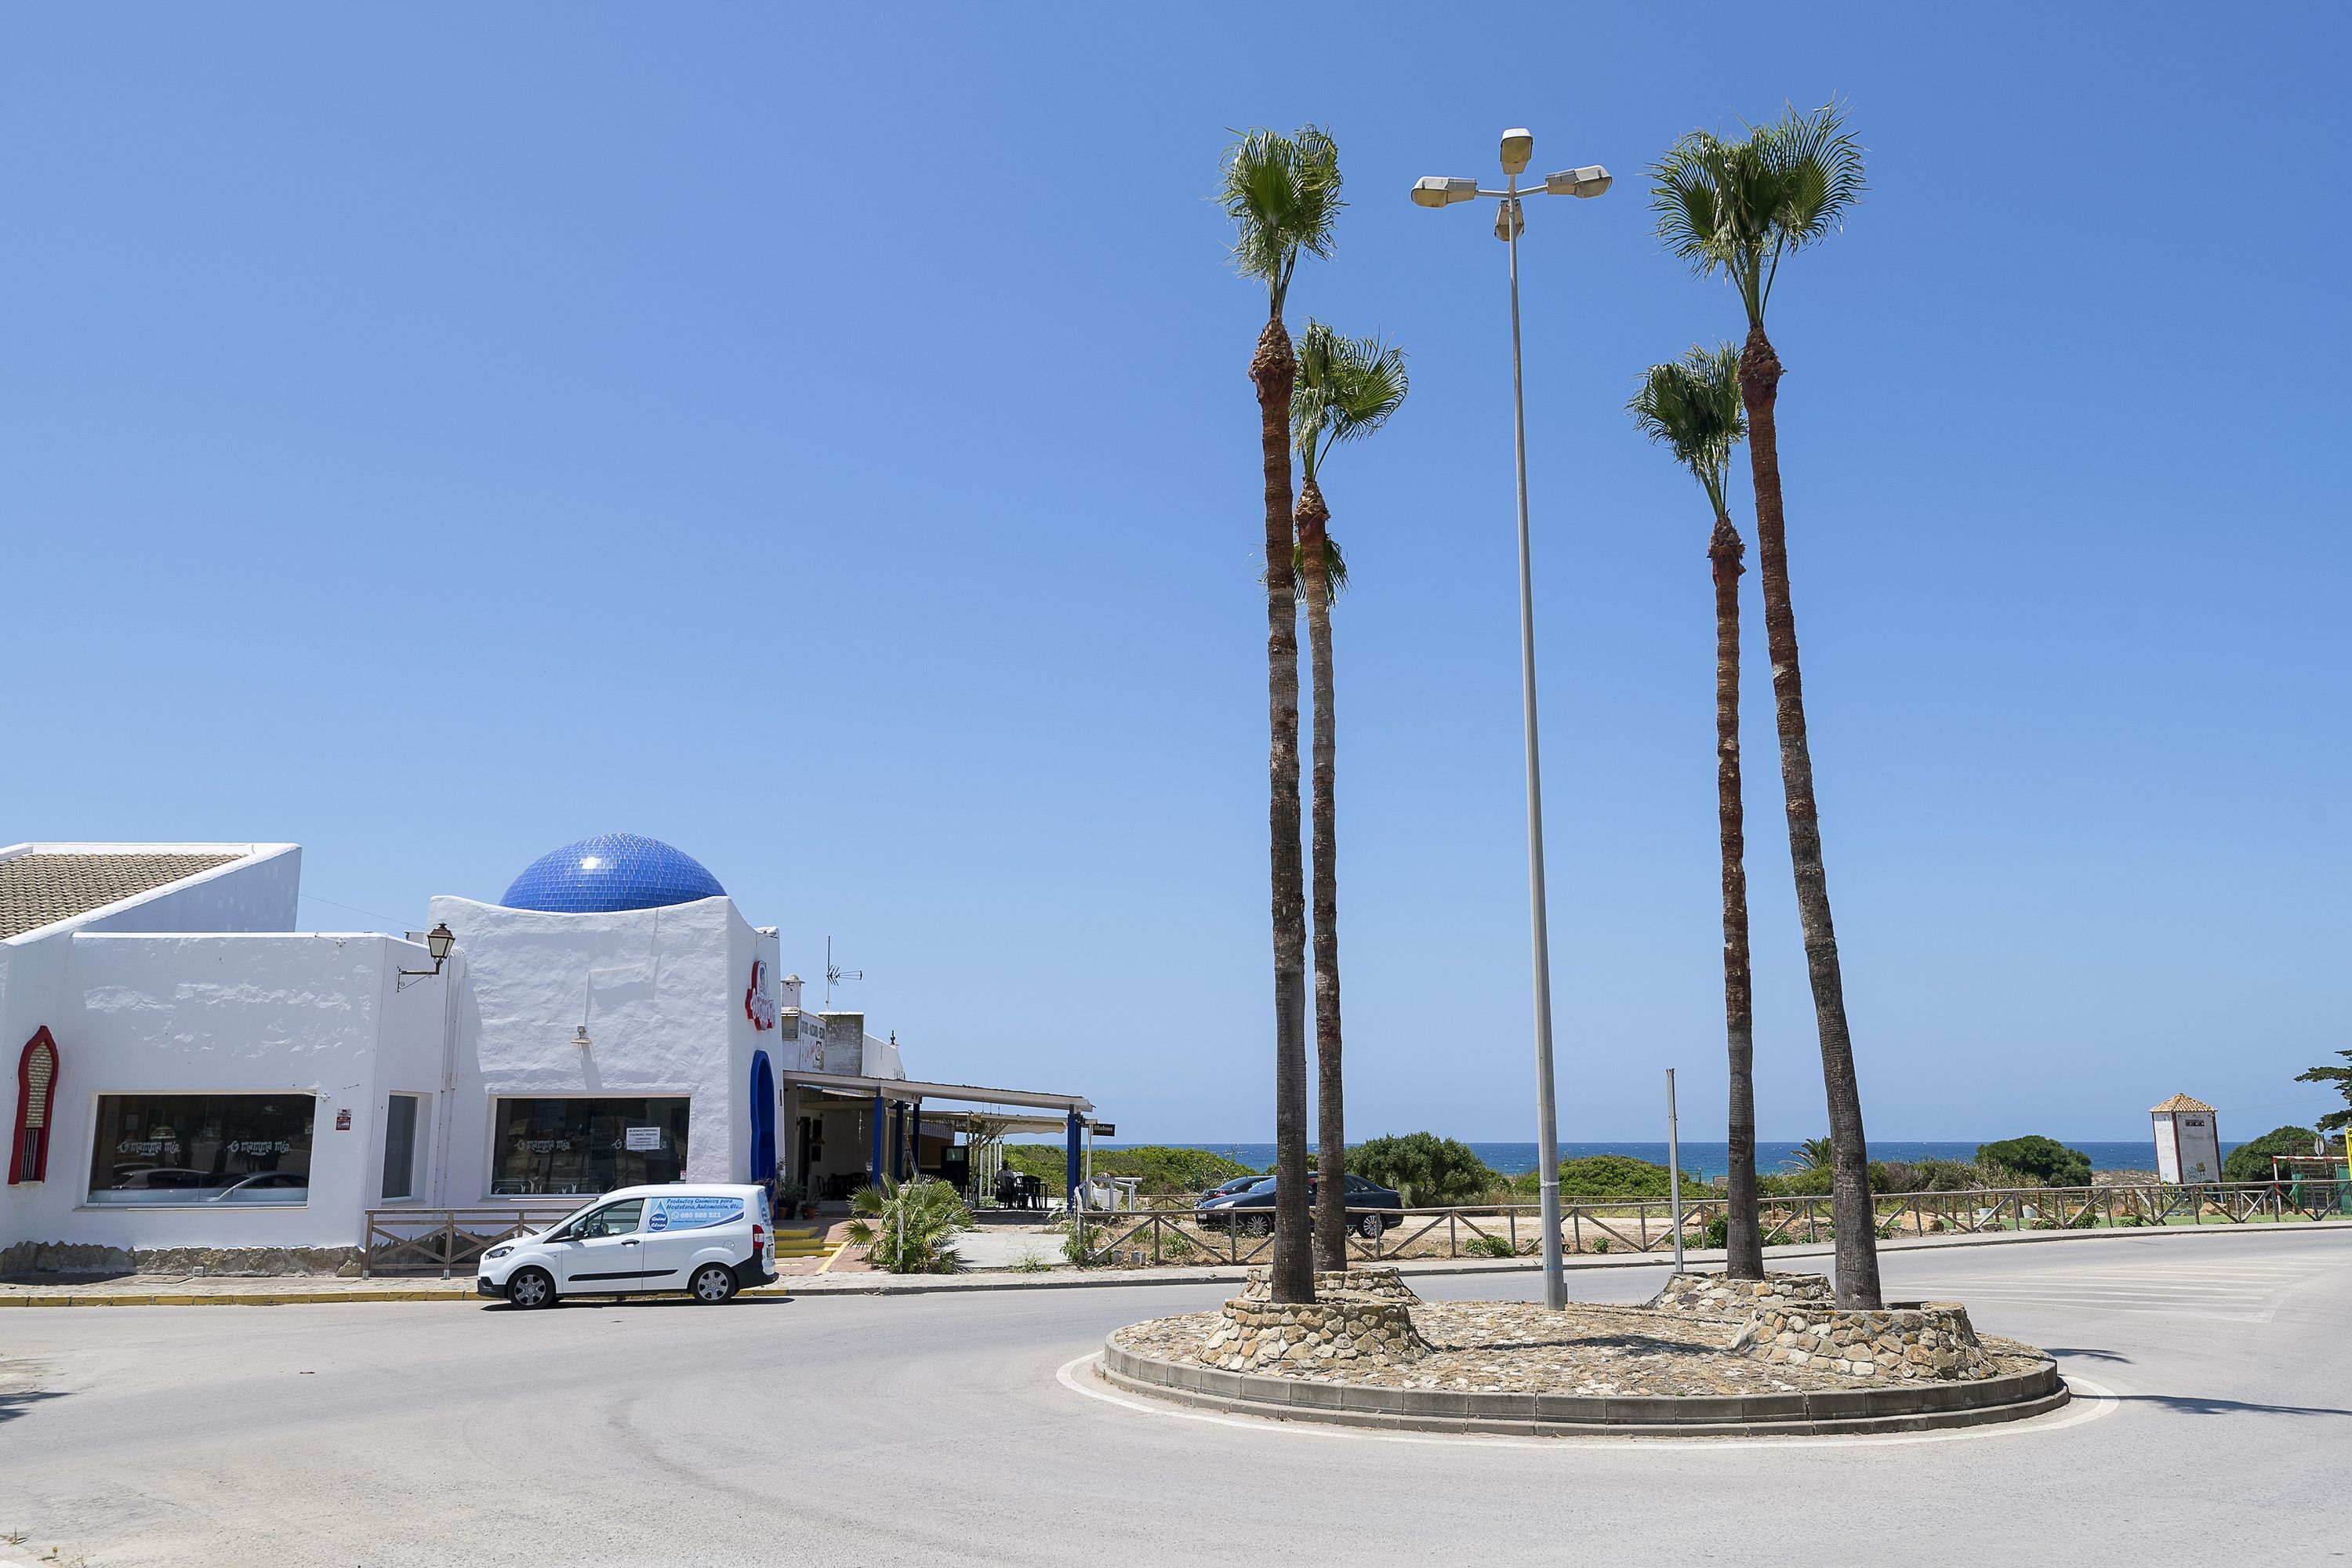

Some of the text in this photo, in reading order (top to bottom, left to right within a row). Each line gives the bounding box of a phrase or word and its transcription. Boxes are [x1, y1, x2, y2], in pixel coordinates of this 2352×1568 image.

[130, 1141, 162, 1155] mamma
[241, 1141, 272, 1154] mamma
[526, 1140, 555, 1151] mamma
